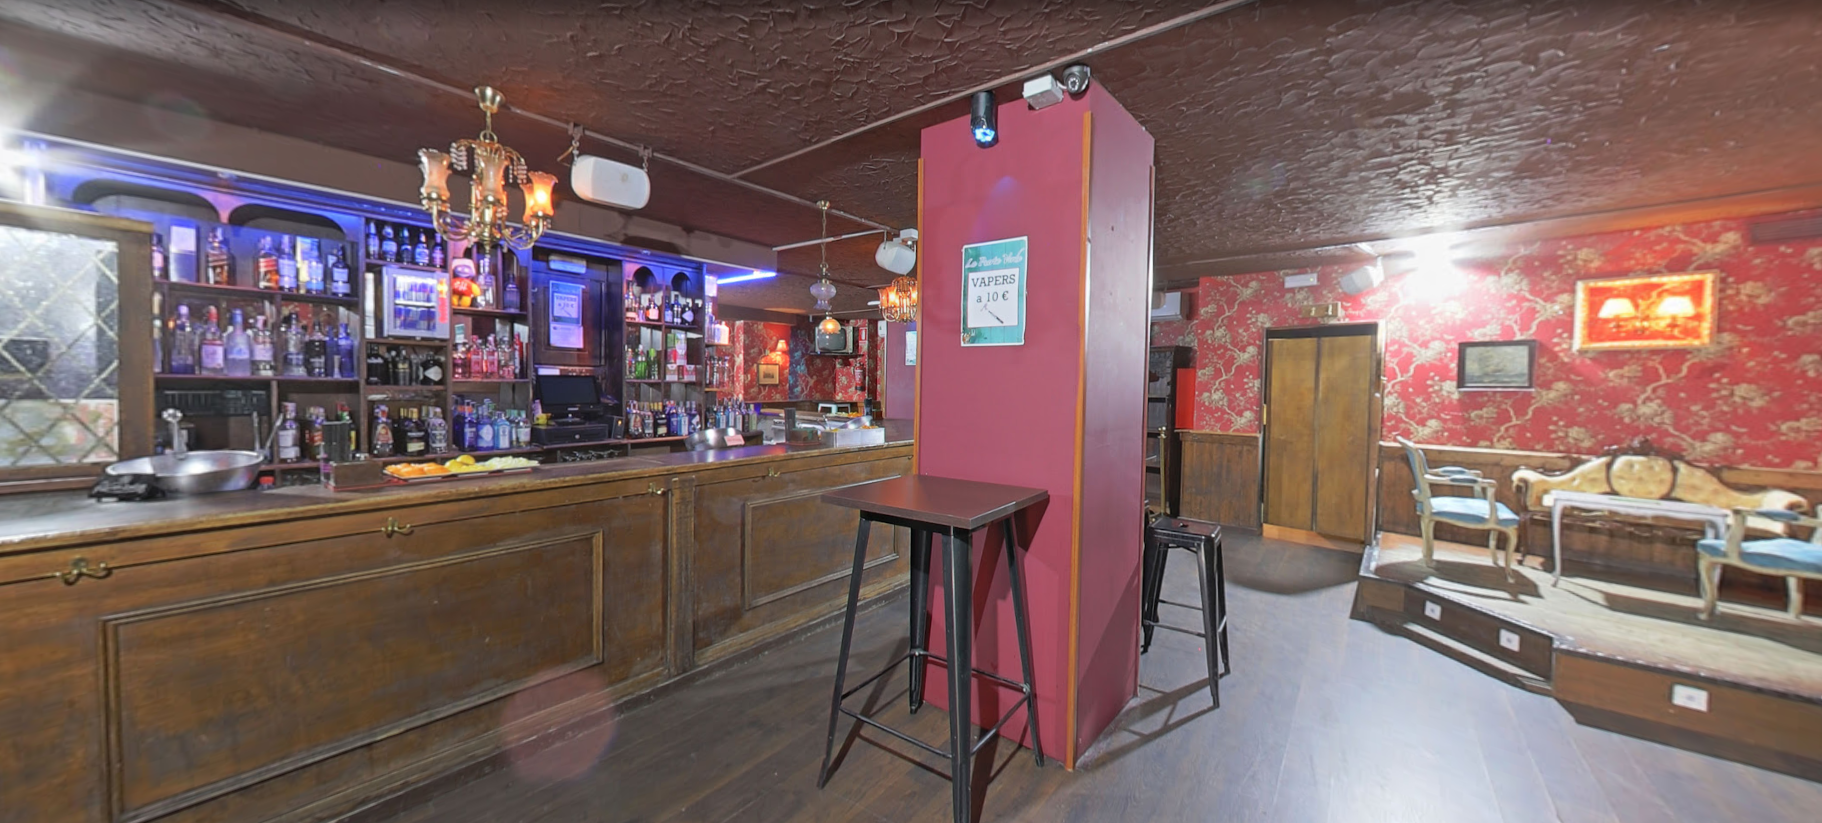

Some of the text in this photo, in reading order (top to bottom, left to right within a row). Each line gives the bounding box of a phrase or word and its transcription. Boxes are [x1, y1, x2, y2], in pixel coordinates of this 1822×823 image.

[971, 274, 1016, 288] VAPERS
[976, 290, 1009, 303] a 10 €
